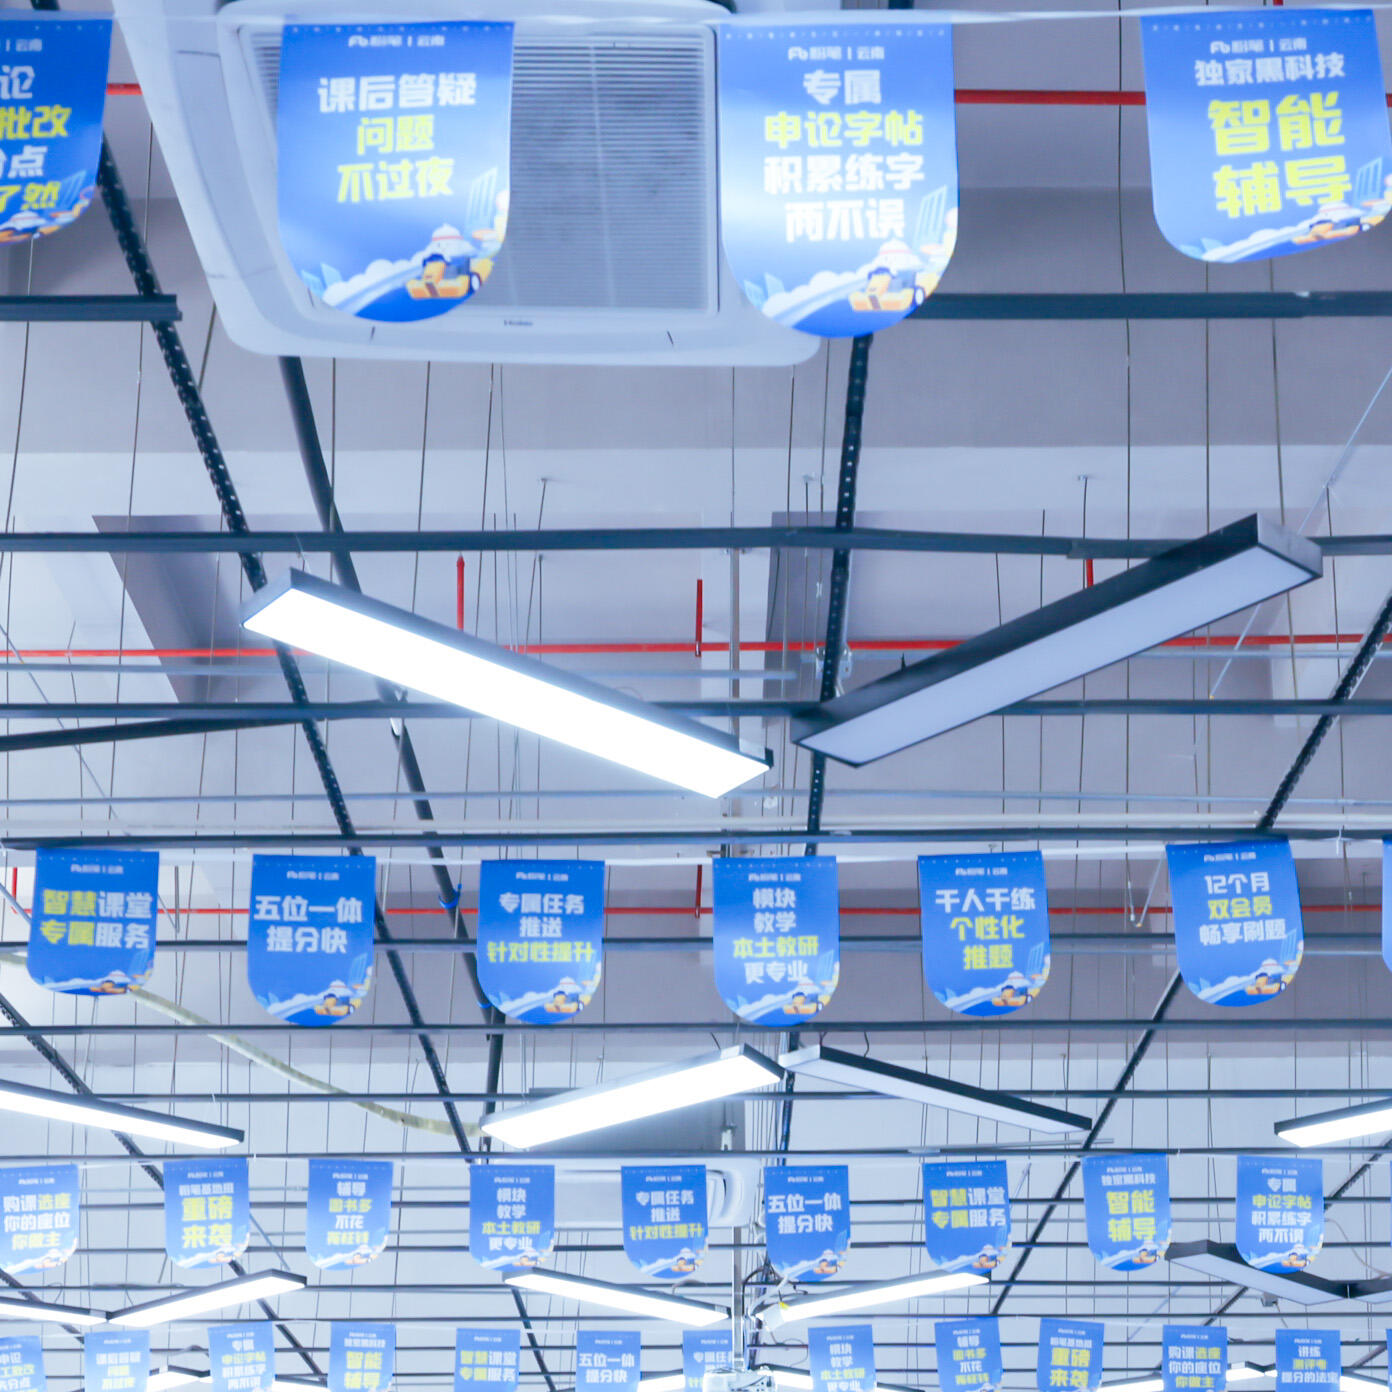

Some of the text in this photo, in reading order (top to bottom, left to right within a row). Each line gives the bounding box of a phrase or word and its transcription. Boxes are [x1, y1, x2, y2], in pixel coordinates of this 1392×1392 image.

[1194, 52, 1346, 86] 独家黑科技
[803, 69, 882, 106] 专属
[357, 115, 435, 155] 问题
[764, 110, 924, 149] 申论字帖
[1207, 91, 1346, 156] 智能
[336, 157, 456, 204] 不过夜
[763, 153, 925, 195] 积累练字
[1213, 155, 1353, 218] 辅导
[785, 198, 907, 243] 两不误
[1204, 872, 1270, 895] 12个月
[43, 889, 153, 918] 智慧课堂
[254, 895, 363, 924] 五位一体
[499, 892, 585, 915] 专属任务
[752, 888, 796, 909] 模块
[936, 888, 1036, 914] 千人千练
[1208, 895, 1273, 920] 双会员
[40, 920, 151, 948] 专属服务
[519, 917, 562, 938] 推送
[754, 911, 796, 933] 教学
[951, 915, 1025, 941] 个性化
[1199, 919, 1288, 946] 畅享刷题
[267, 926, 348, 954] 提分快
[487, 941, 596, 963] 针对性提升
[733, 935, 820, 958] 本土教研
[963, 945, 1014, 970] 推题
[744, 961, 809, 984] 更专业
[768, 1192, 842, 1213] 五位一体
[1106, 1189, 1156, 1215] 智能
[778, 1215, 834, 1235] 提分快
[1108, 1217, 1157, 1242] 辅导
